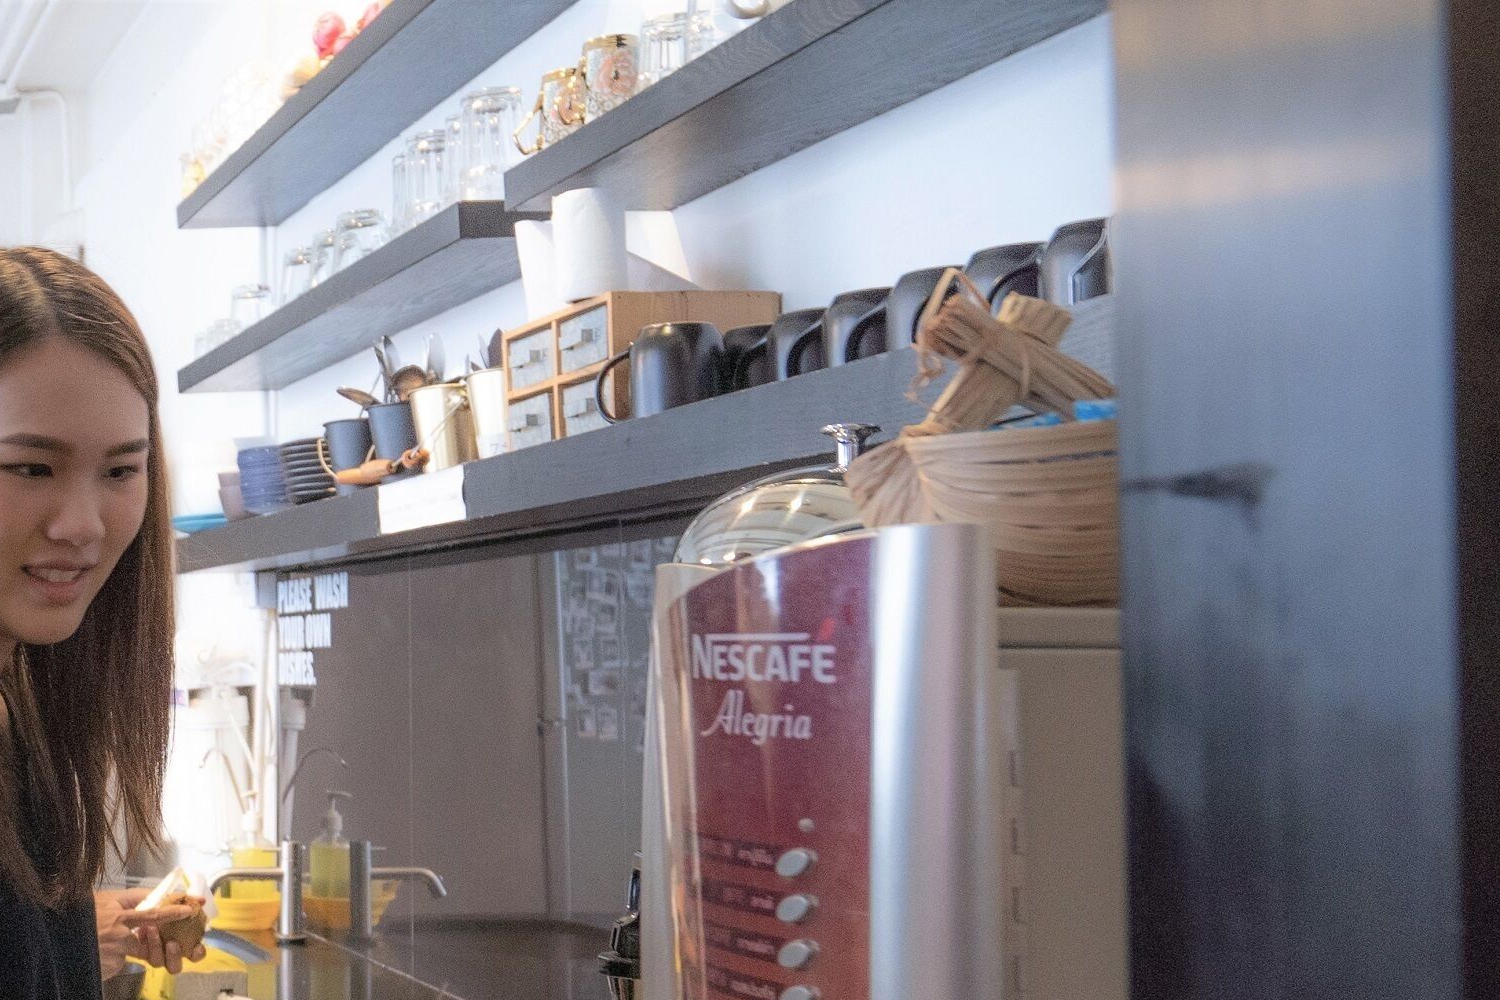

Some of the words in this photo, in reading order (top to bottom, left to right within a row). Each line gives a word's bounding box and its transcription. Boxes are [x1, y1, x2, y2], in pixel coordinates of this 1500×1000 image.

[277, 577, 312, 614] PLEASE
[314, 571, 348, 609] WASH
[305, 612, 331, 649] OWN
[700, 688, 813, 746] Alegria
